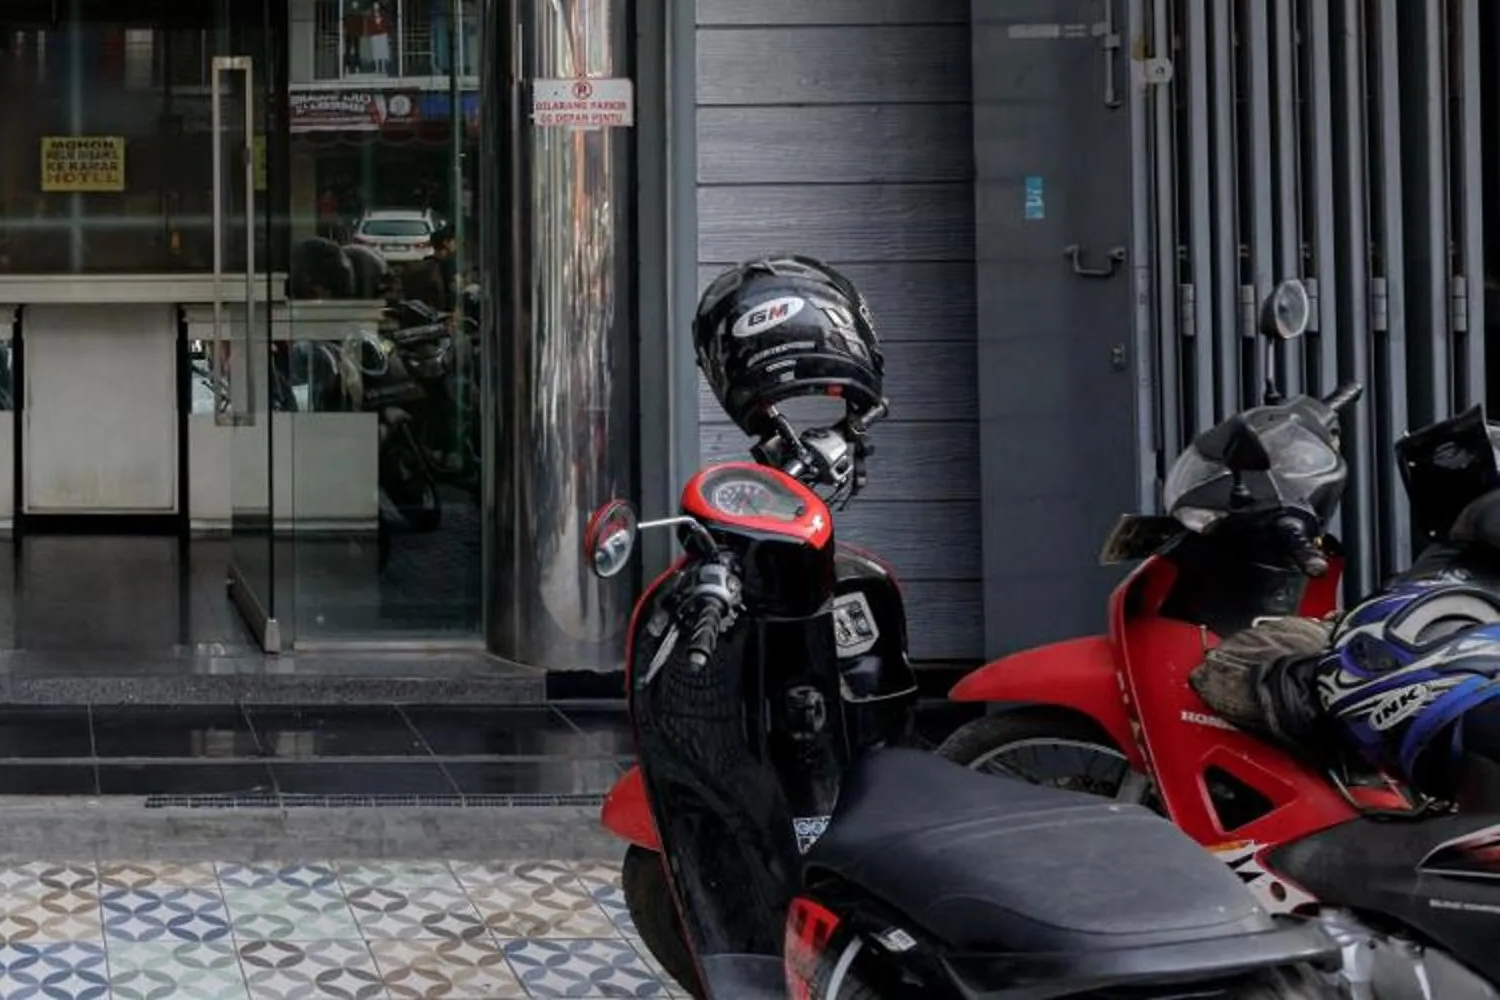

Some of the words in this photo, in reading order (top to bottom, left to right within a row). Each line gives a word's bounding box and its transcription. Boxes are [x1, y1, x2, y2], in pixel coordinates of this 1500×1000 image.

[748, 303, 790, 327] GM
[1375, 687, 1419, 726] INK
[1180, 711, 1238, 731] HON
